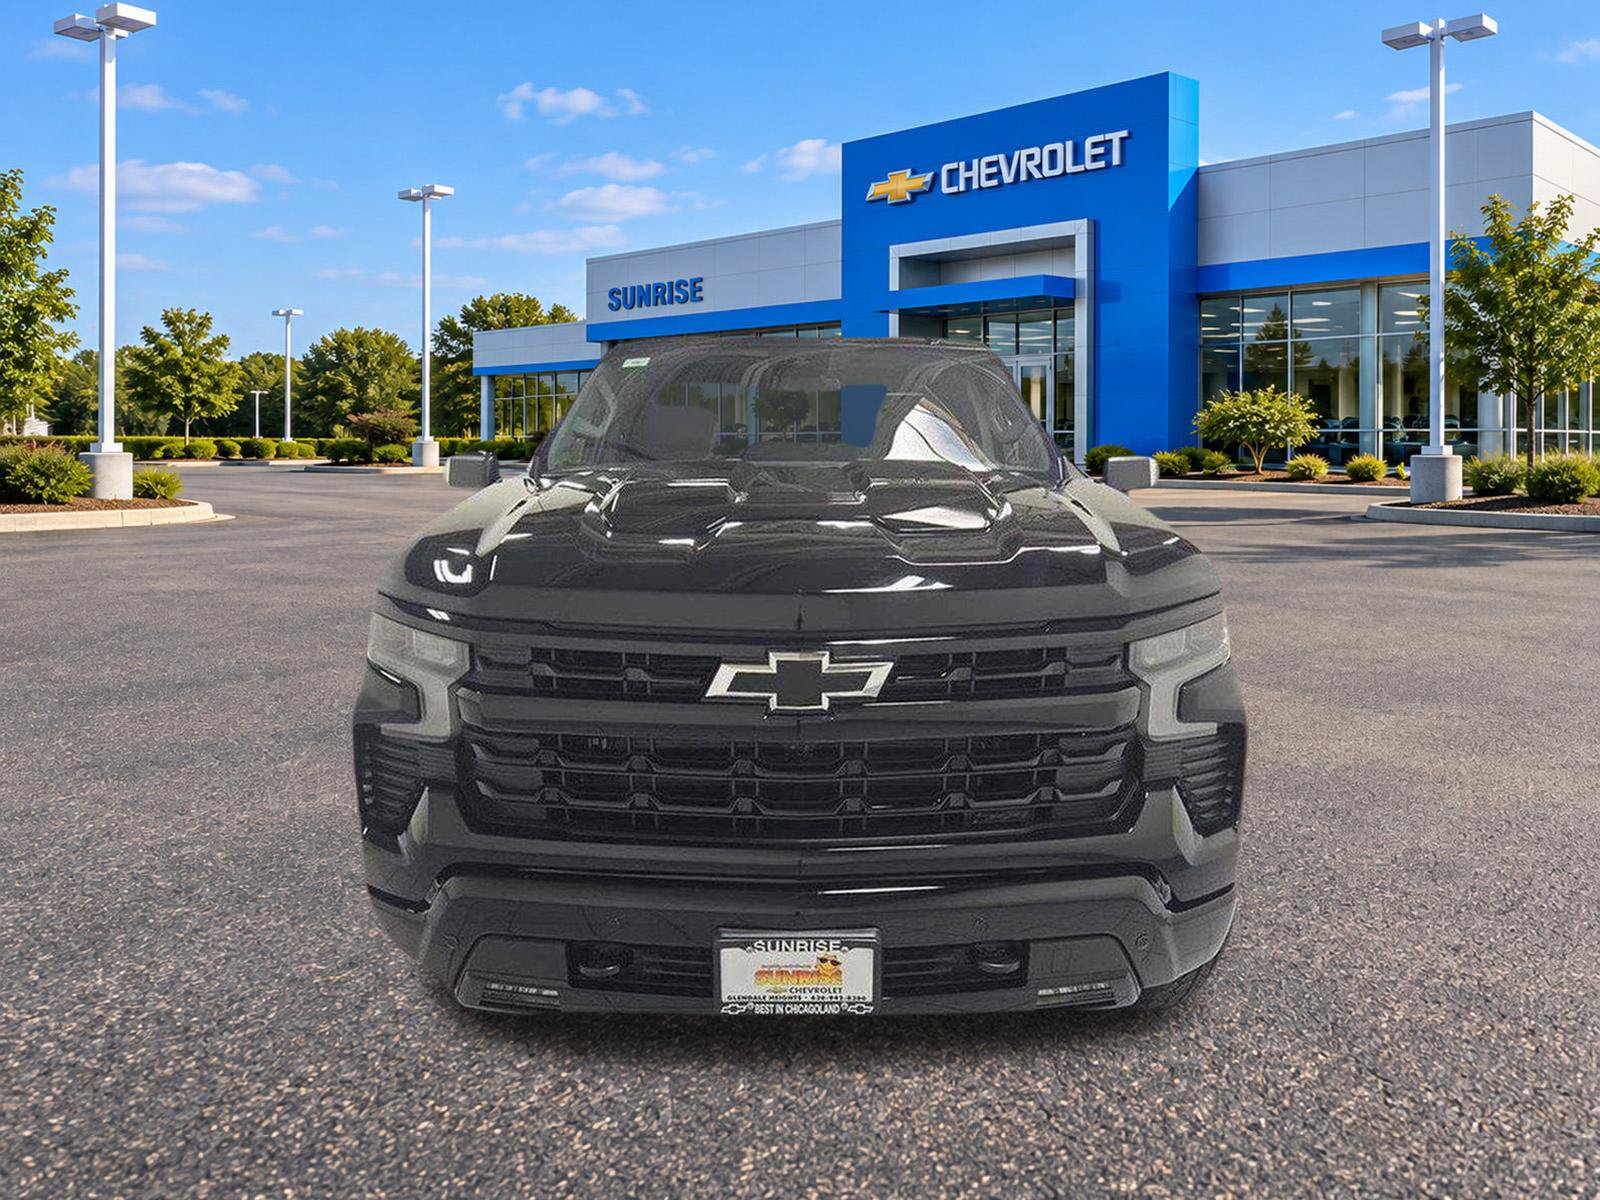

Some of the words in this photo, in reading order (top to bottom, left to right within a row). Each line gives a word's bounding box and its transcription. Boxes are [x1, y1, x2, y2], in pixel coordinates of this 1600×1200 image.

[941, 130, 1129, 194] CHEVROLET
[608, 277, 704, 311] SUNRISE
[753, 940, 841, 952] SUNRISE
[754, 1003, 774, 1014] BEST
[775, 1003, 784, 1014] IN
[785, 1003, 840, 1014] CHICAGOLAND
